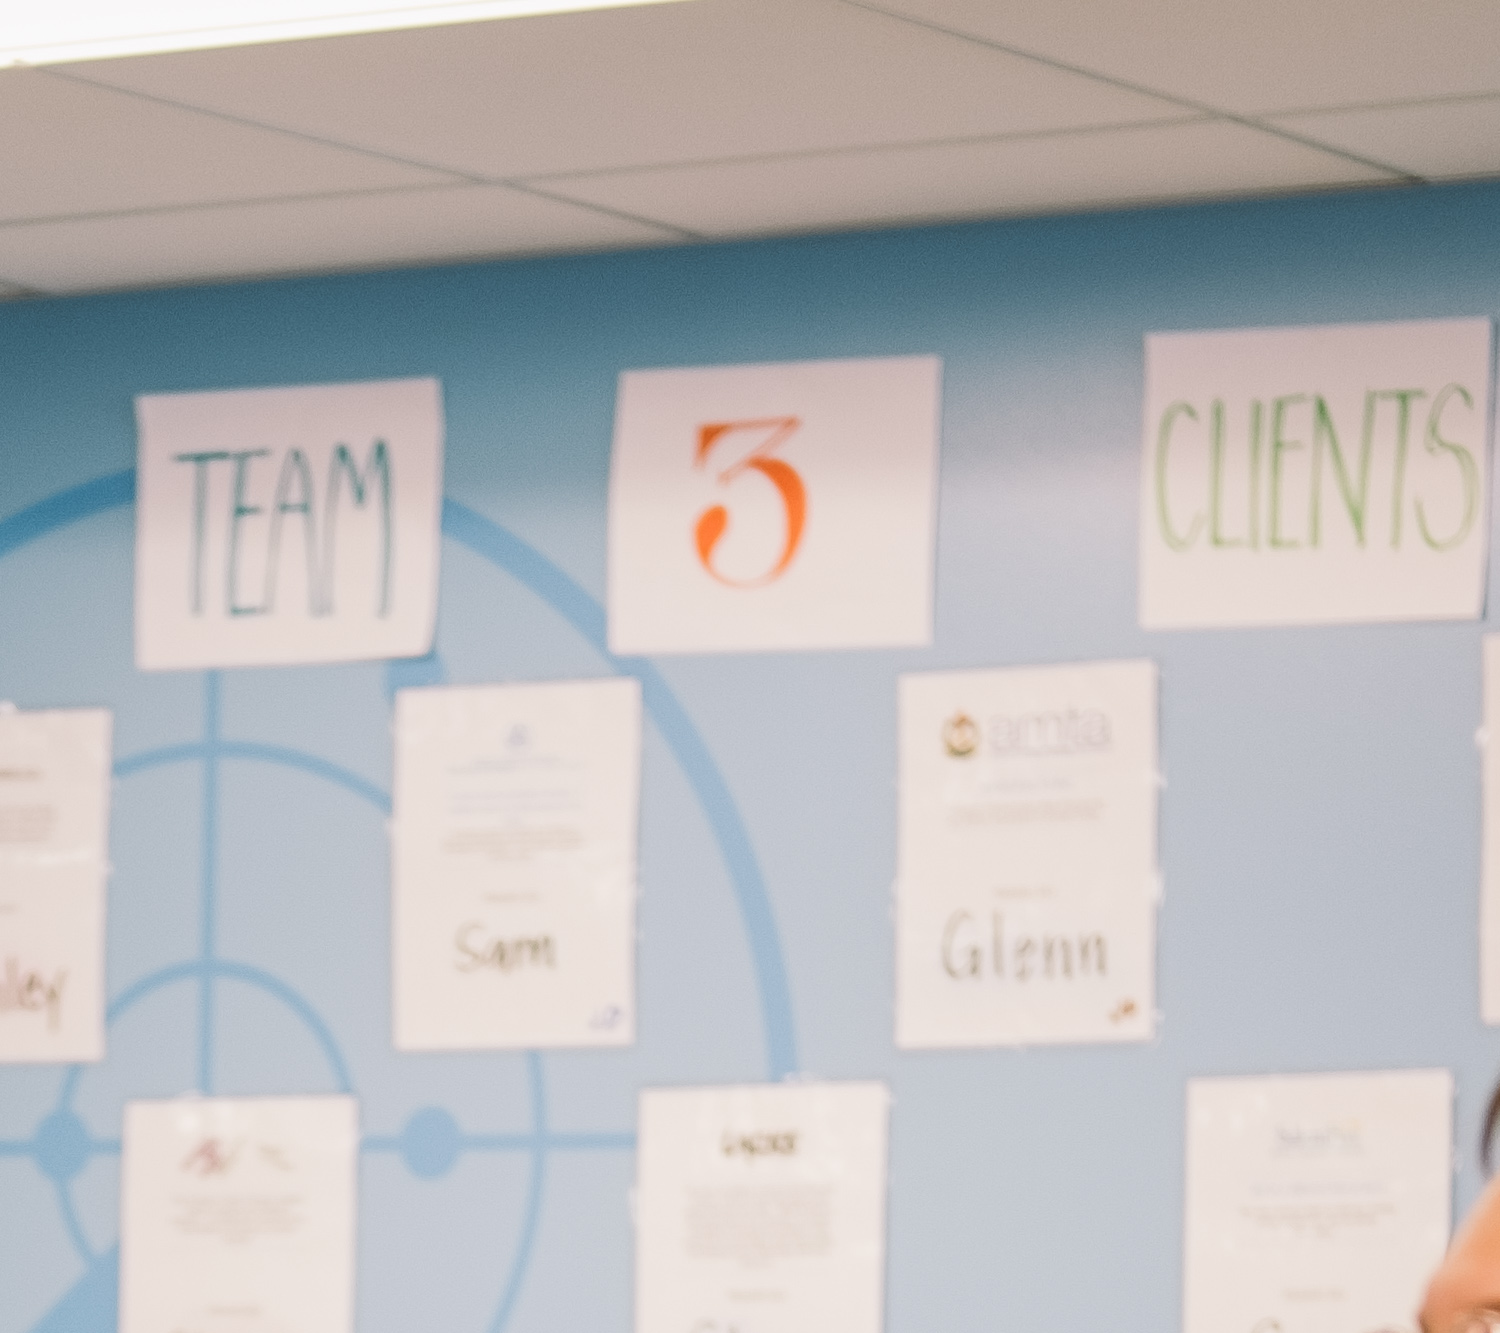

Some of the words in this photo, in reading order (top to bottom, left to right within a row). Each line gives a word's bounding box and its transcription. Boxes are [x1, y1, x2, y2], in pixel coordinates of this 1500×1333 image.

[172, 436, 393, 622] TEAM
[691, 414, 811, 592] 3
[1153, 382, 1481, 557] CLIENTS
[453, 921, 559, 976] Sam
[940, 906, 1111, 985] Glenn
